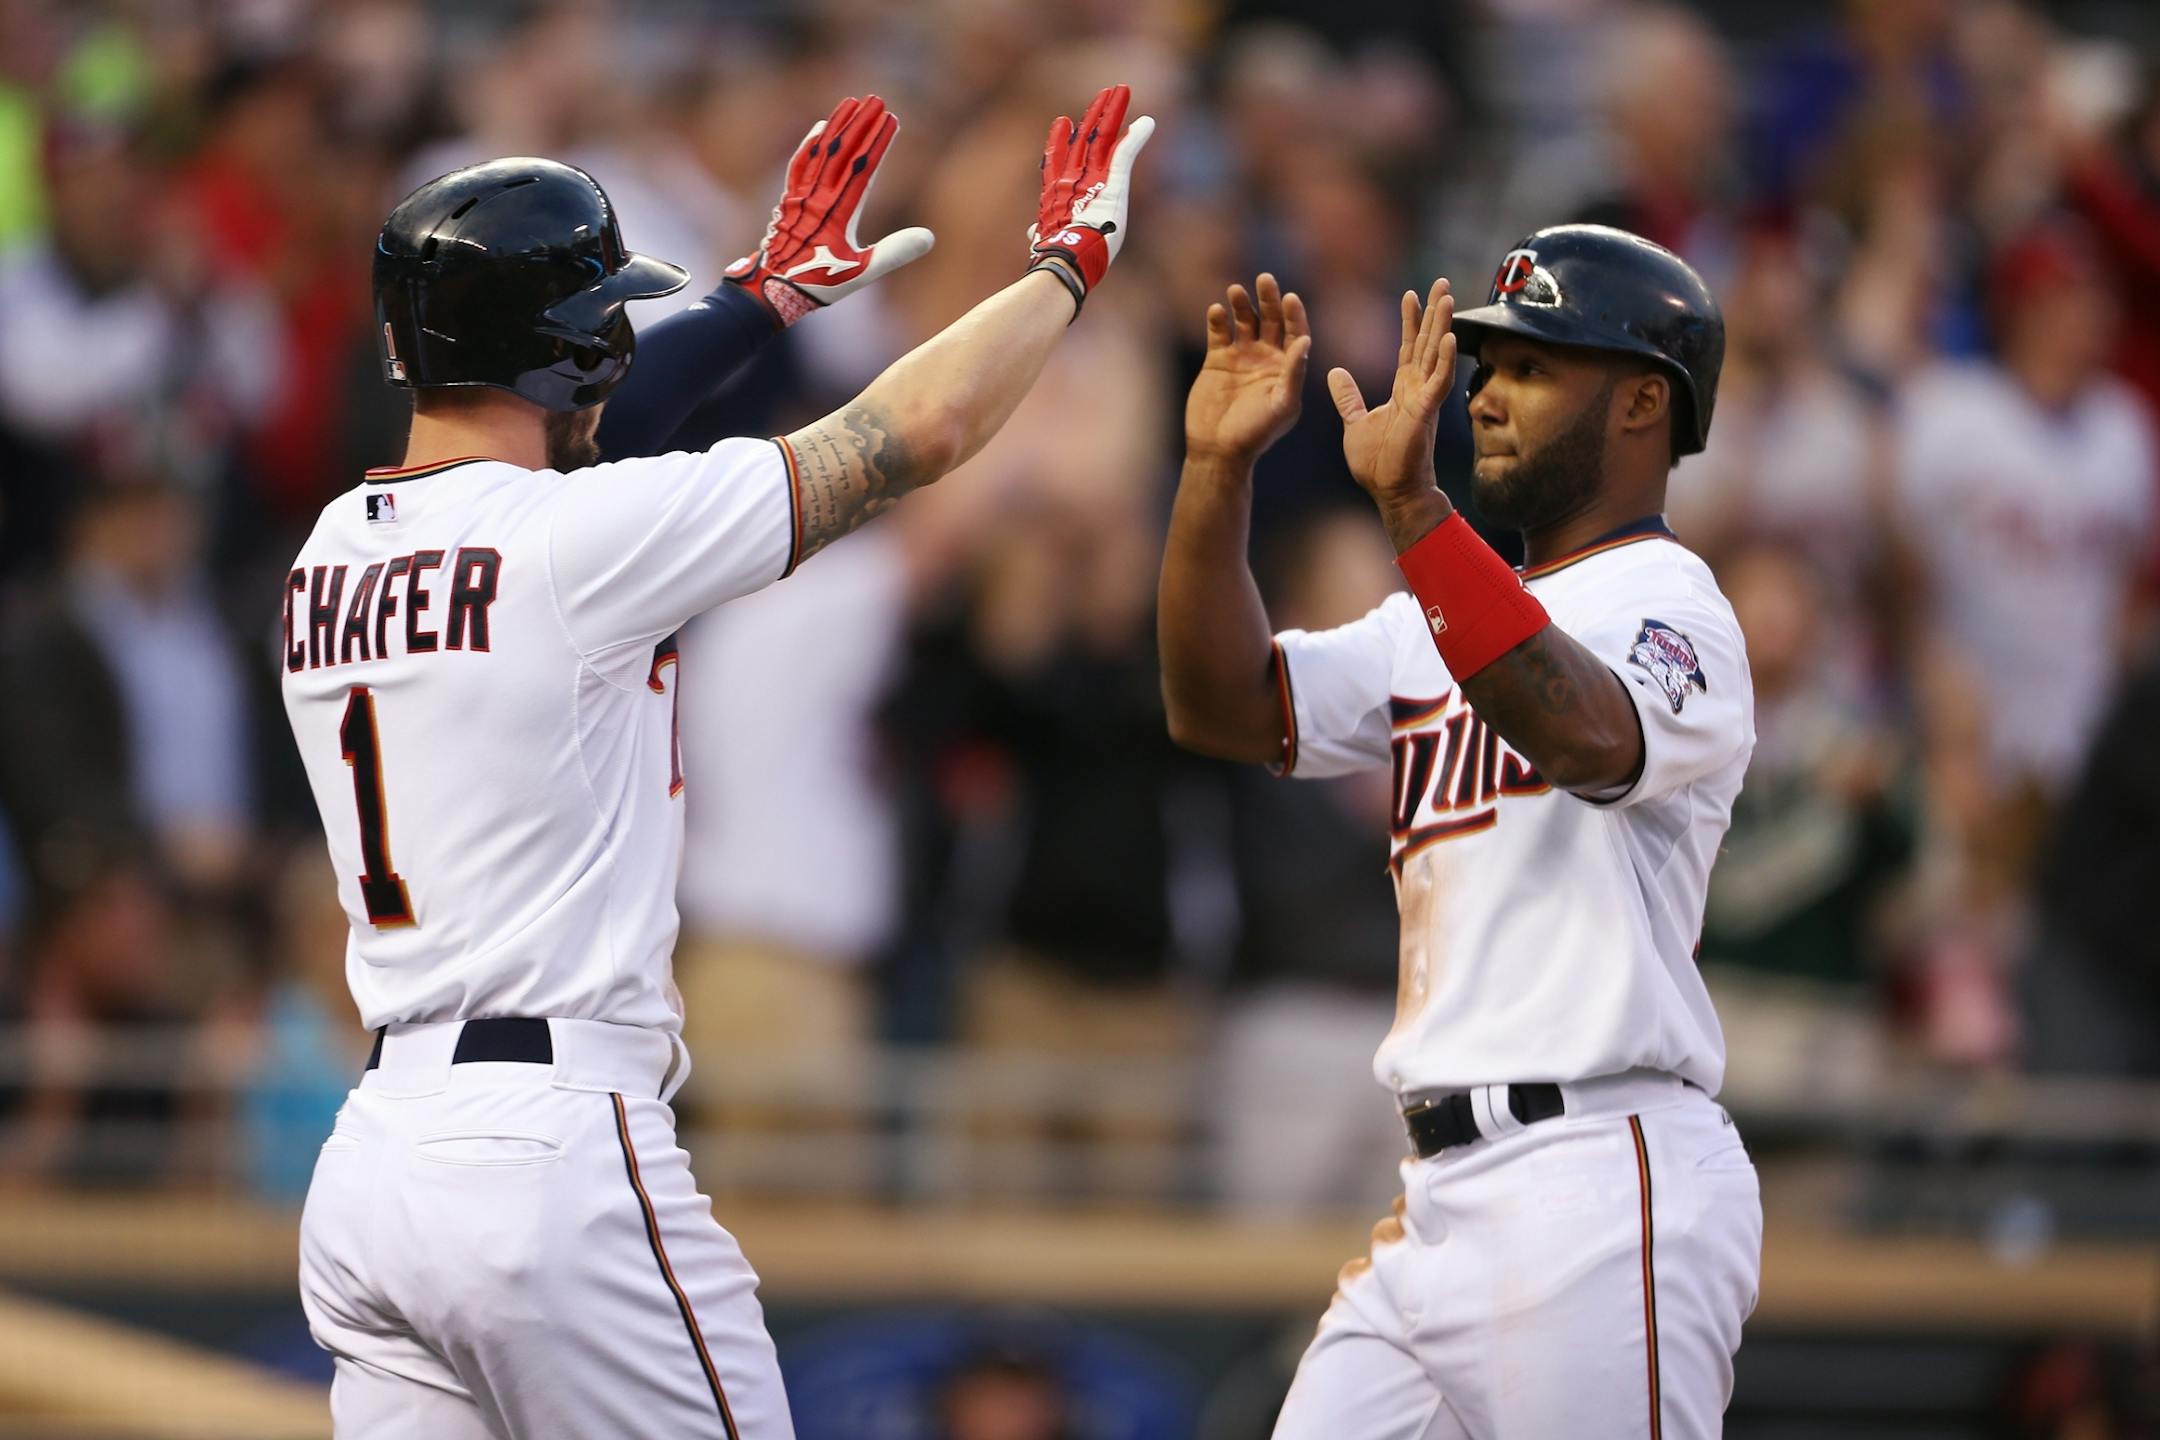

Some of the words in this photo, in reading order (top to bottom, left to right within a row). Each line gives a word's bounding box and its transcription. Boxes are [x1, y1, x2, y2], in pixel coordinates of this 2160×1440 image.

[281, 547, 502, 674] CHAFER
[340, 686, 420, 931] 1
[1390, 690, 1552, 843] win
